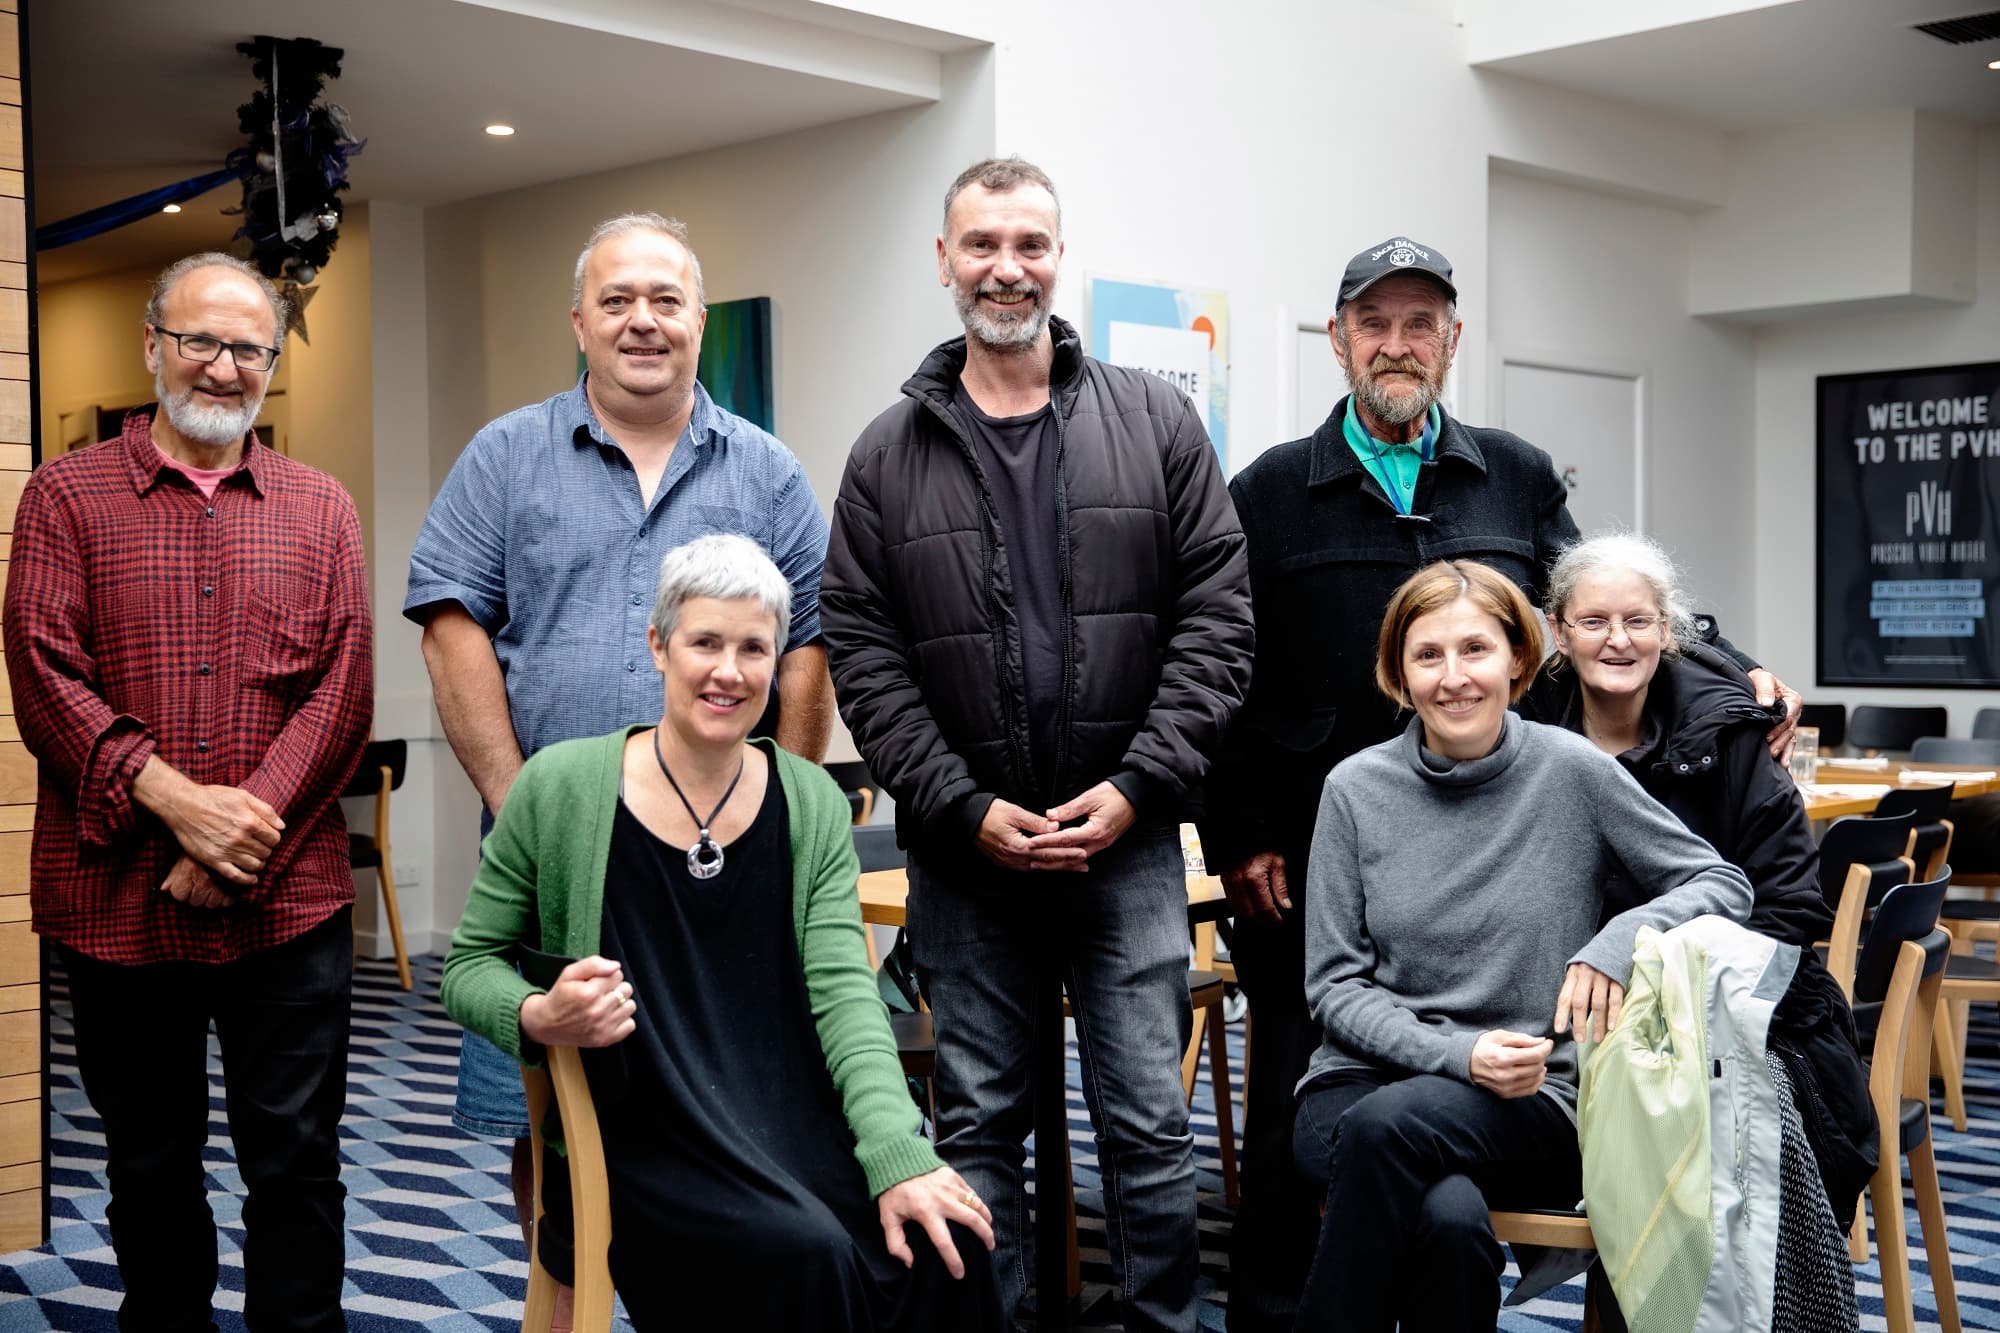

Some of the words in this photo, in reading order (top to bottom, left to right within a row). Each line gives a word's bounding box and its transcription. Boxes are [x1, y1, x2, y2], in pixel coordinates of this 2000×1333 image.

[1371, 243, 1394, 261] JACK
[1867, 395, 1989, 431] WELCOME
[1854, 437, 1886, 464] TO
[1894, 433, 1942, 463] THE
[1950, 429, 2000, 459] PVH
[1905, 480, 1952, 537] PVH
